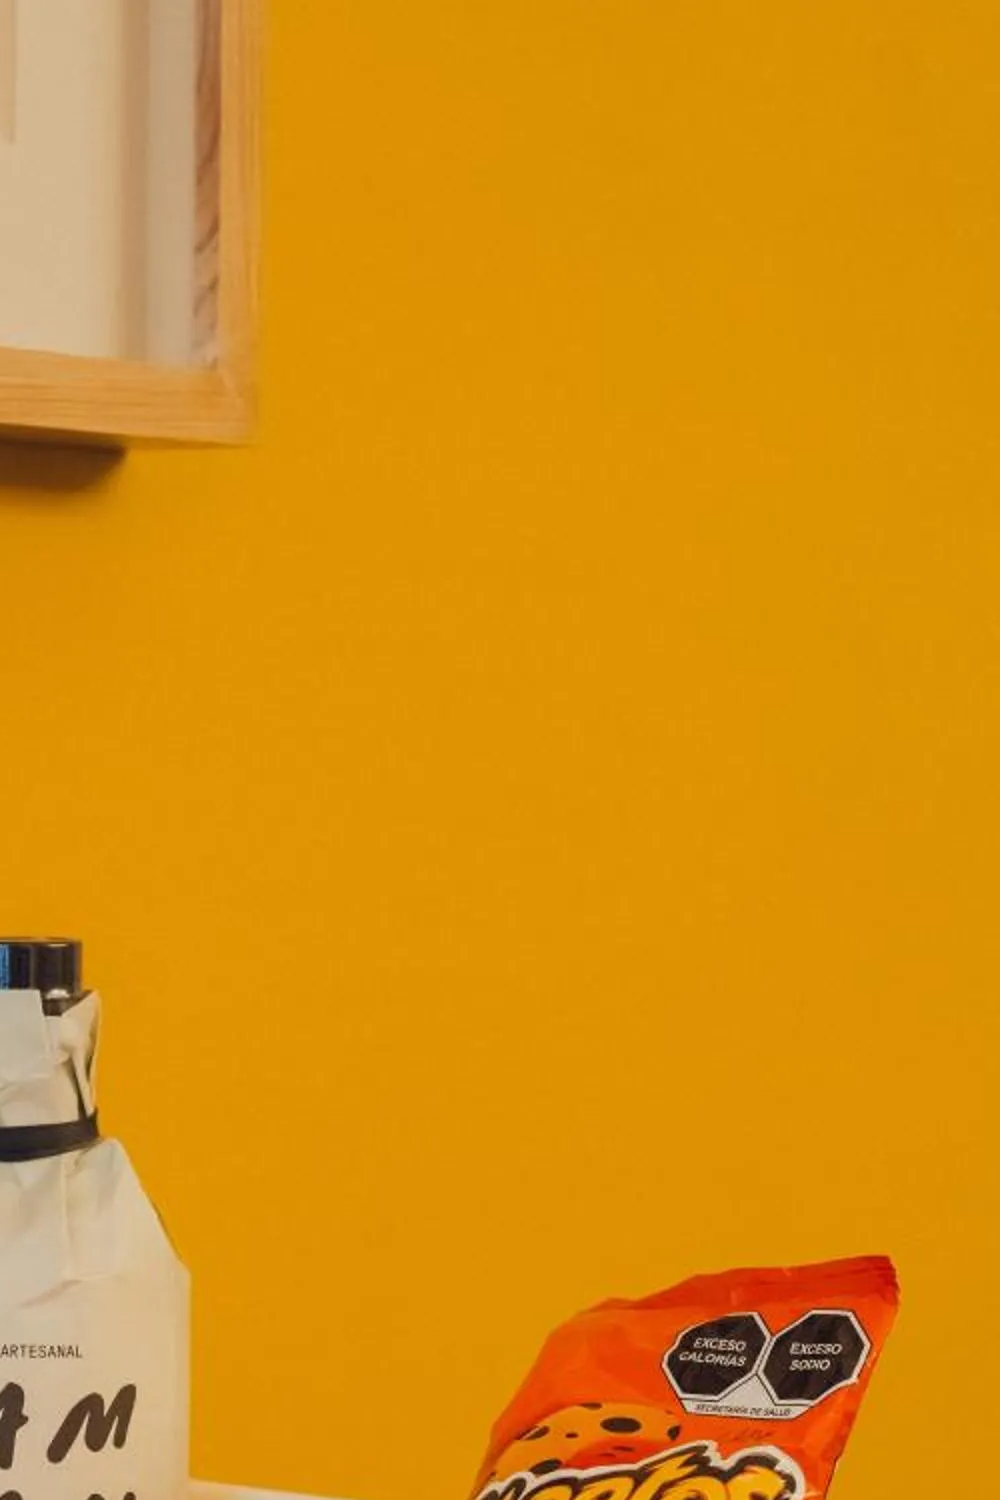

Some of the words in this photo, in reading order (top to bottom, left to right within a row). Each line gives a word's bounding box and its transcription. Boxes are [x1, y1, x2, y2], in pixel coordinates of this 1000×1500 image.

[0, 1343, 84, 1359] ARTESANAL
[693, 1336, 747, 1352] EXCESO
[788, 1342, 842, 1356] EXCESO
[678, 1351, 747, 1367] CALORÍAS
[788, 1358, 832, 1372] SODIO
